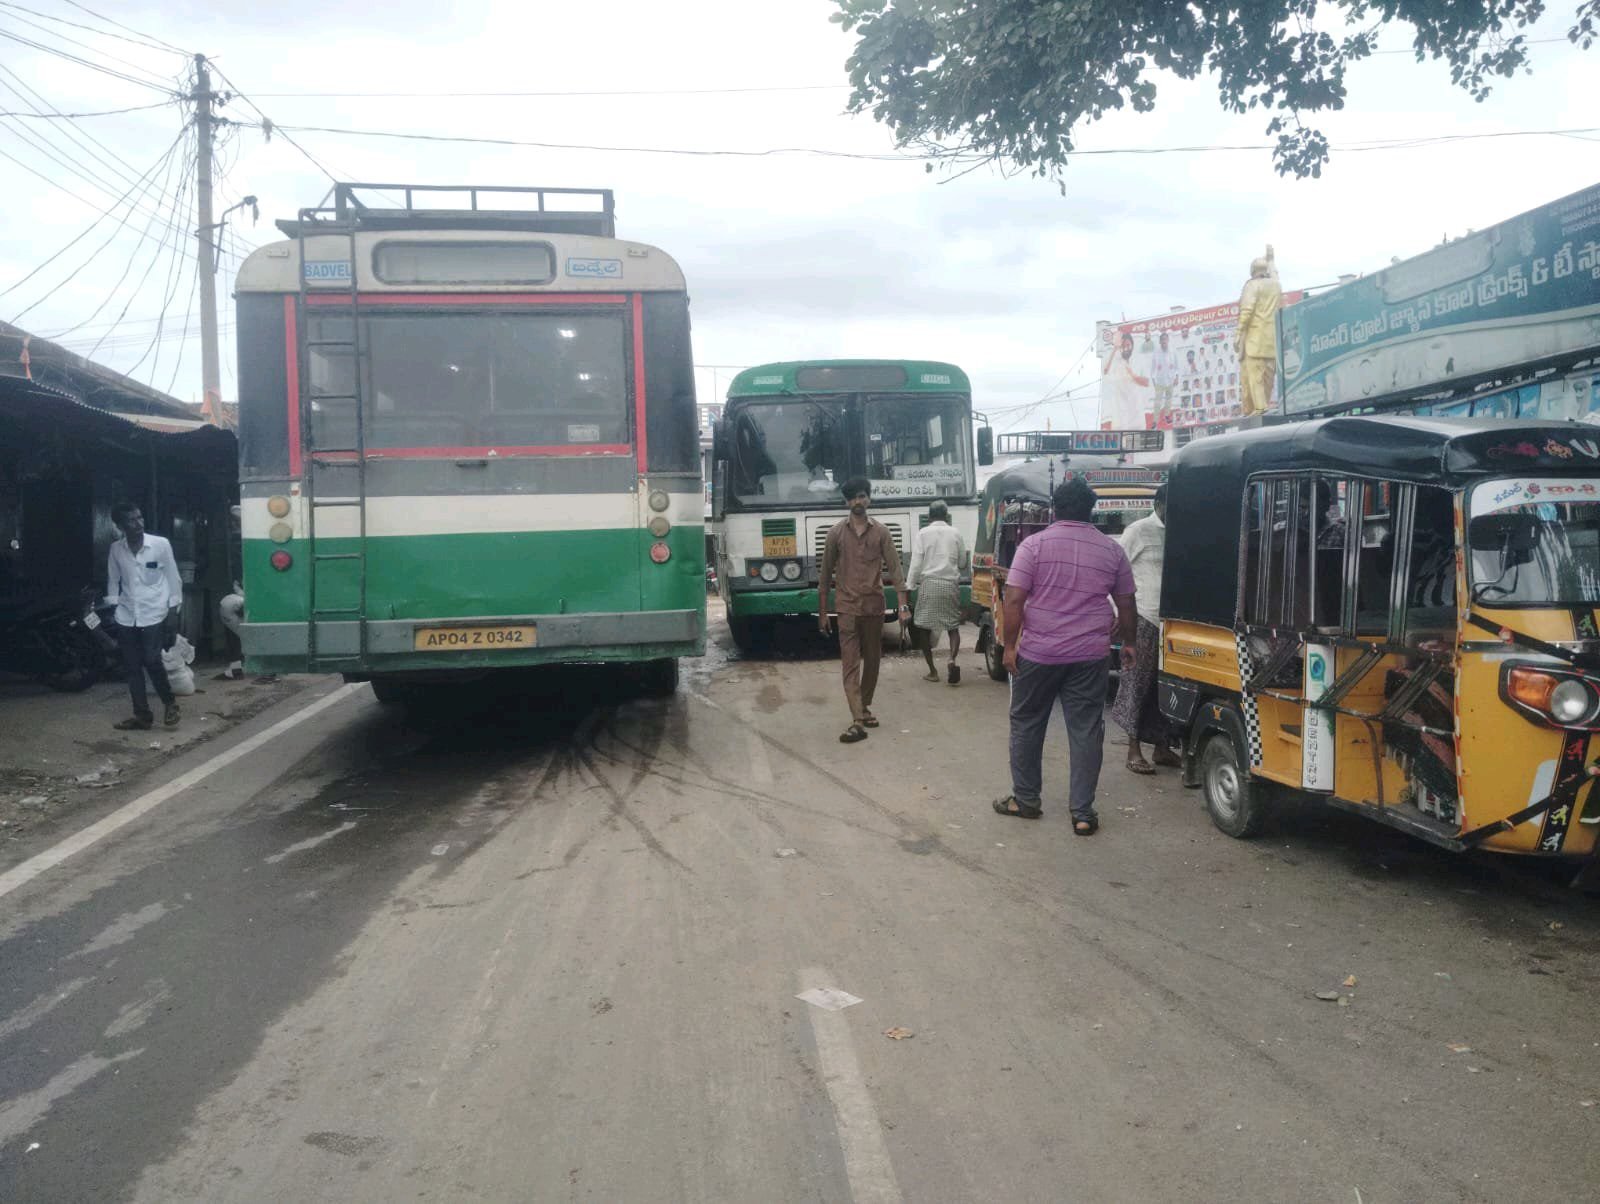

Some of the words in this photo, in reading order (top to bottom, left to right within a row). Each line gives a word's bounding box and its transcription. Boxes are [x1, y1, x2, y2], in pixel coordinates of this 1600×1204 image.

[304, 263, 352, 277] BADVEL
[1434, 281, 1474, 315] కూల్
[1478, 264, 1528, 306] డ్రింక్స్
[1553, 242, 1573, 278] టీ
[1217, 307, 1230, 316] CM
[1075, 433, 1119, 449] KGN
[473, 632, 482, 644] Z
[486, 631, 523, 644] 0342
